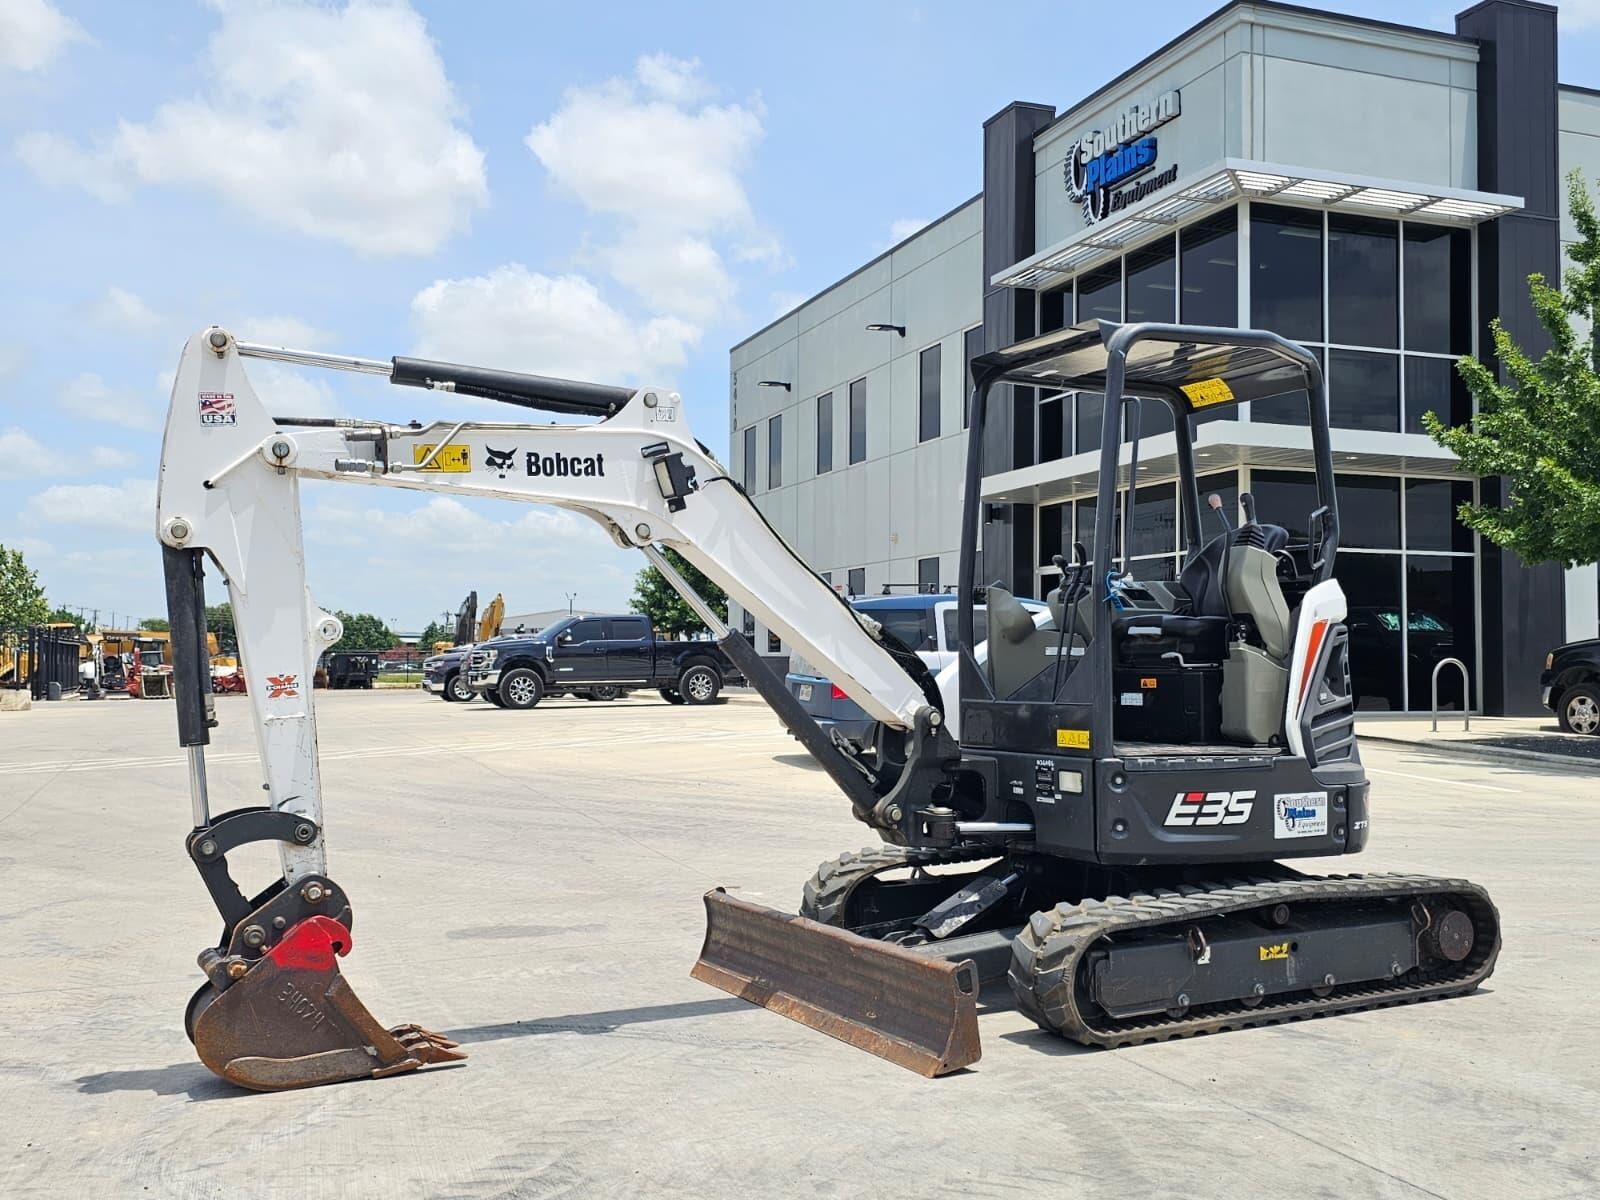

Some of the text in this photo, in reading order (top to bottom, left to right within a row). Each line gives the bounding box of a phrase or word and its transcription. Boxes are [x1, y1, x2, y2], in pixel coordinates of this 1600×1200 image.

[1080, 89, 1181, 164] Southern
[1086, 136, 1158, 194] Plains
[1110, 163, 1178, 212] Equipment
[203, 414, 234, 423] USA
[526, 452, 605, 477] Bobcat
[1163, 790, 1257, 827] E35
[1286, 796, 1326, 807] Southern
[1287, 807, 1316, 819] Plains
